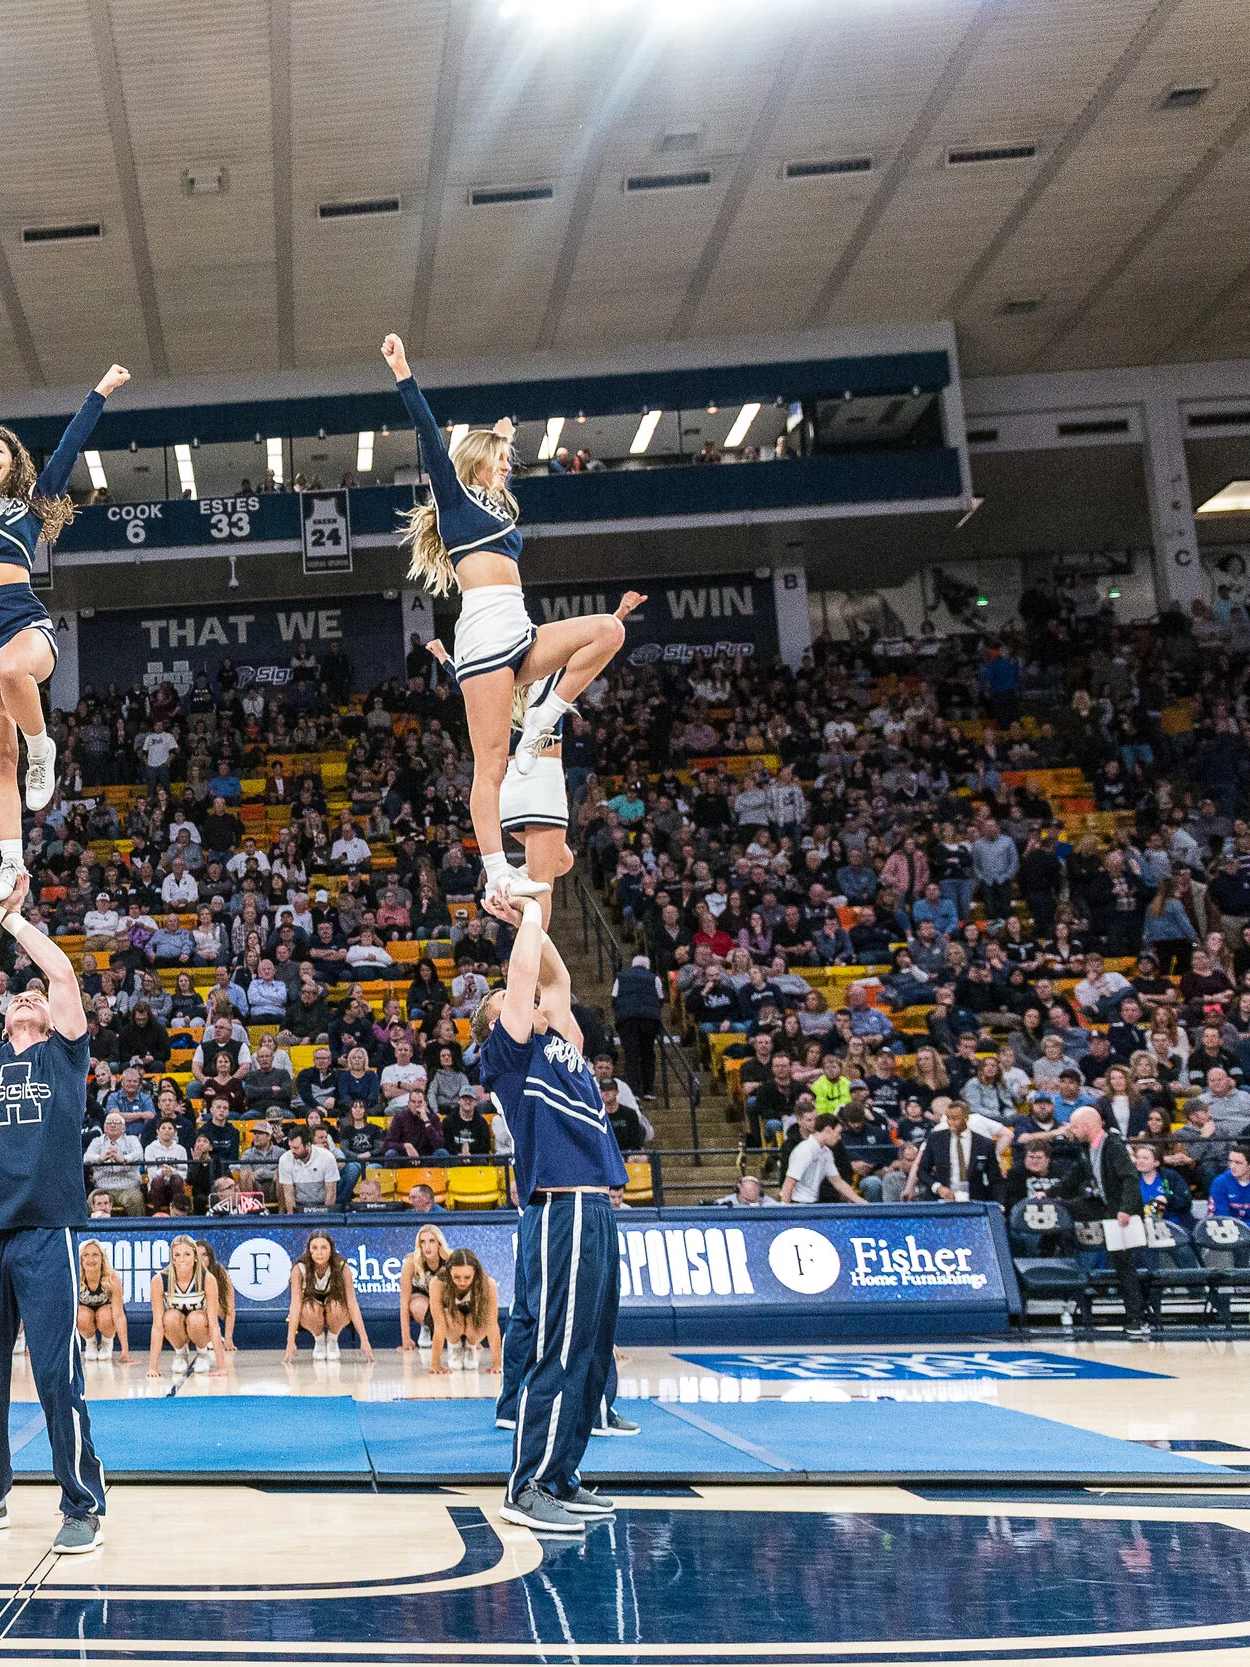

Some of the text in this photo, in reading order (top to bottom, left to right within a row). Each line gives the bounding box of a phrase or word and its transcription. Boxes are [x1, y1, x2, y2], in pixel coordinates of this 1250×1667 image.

[107, 503, 163, 521] COOK
[200, 497, 260, 515] ESTES
[126, 519, 146, 543] 6
[210, 513, 250, 538] 33
[311, 527, 342, 547] 24
[784, 573, 799, 589] B
[411, 594, 425, 612] A
[541, 586, 754, 623] WIL WIN
[56, 615, 70, 633] A
[141, 609, 343, 649] THAT WE
[255, 666, 293, 686] Sig
[850, 1235, 972, 1273] Fisher
[250, 1252, 271, 1285] F
[850, 1271, 988, 1290] Home Furnishings
